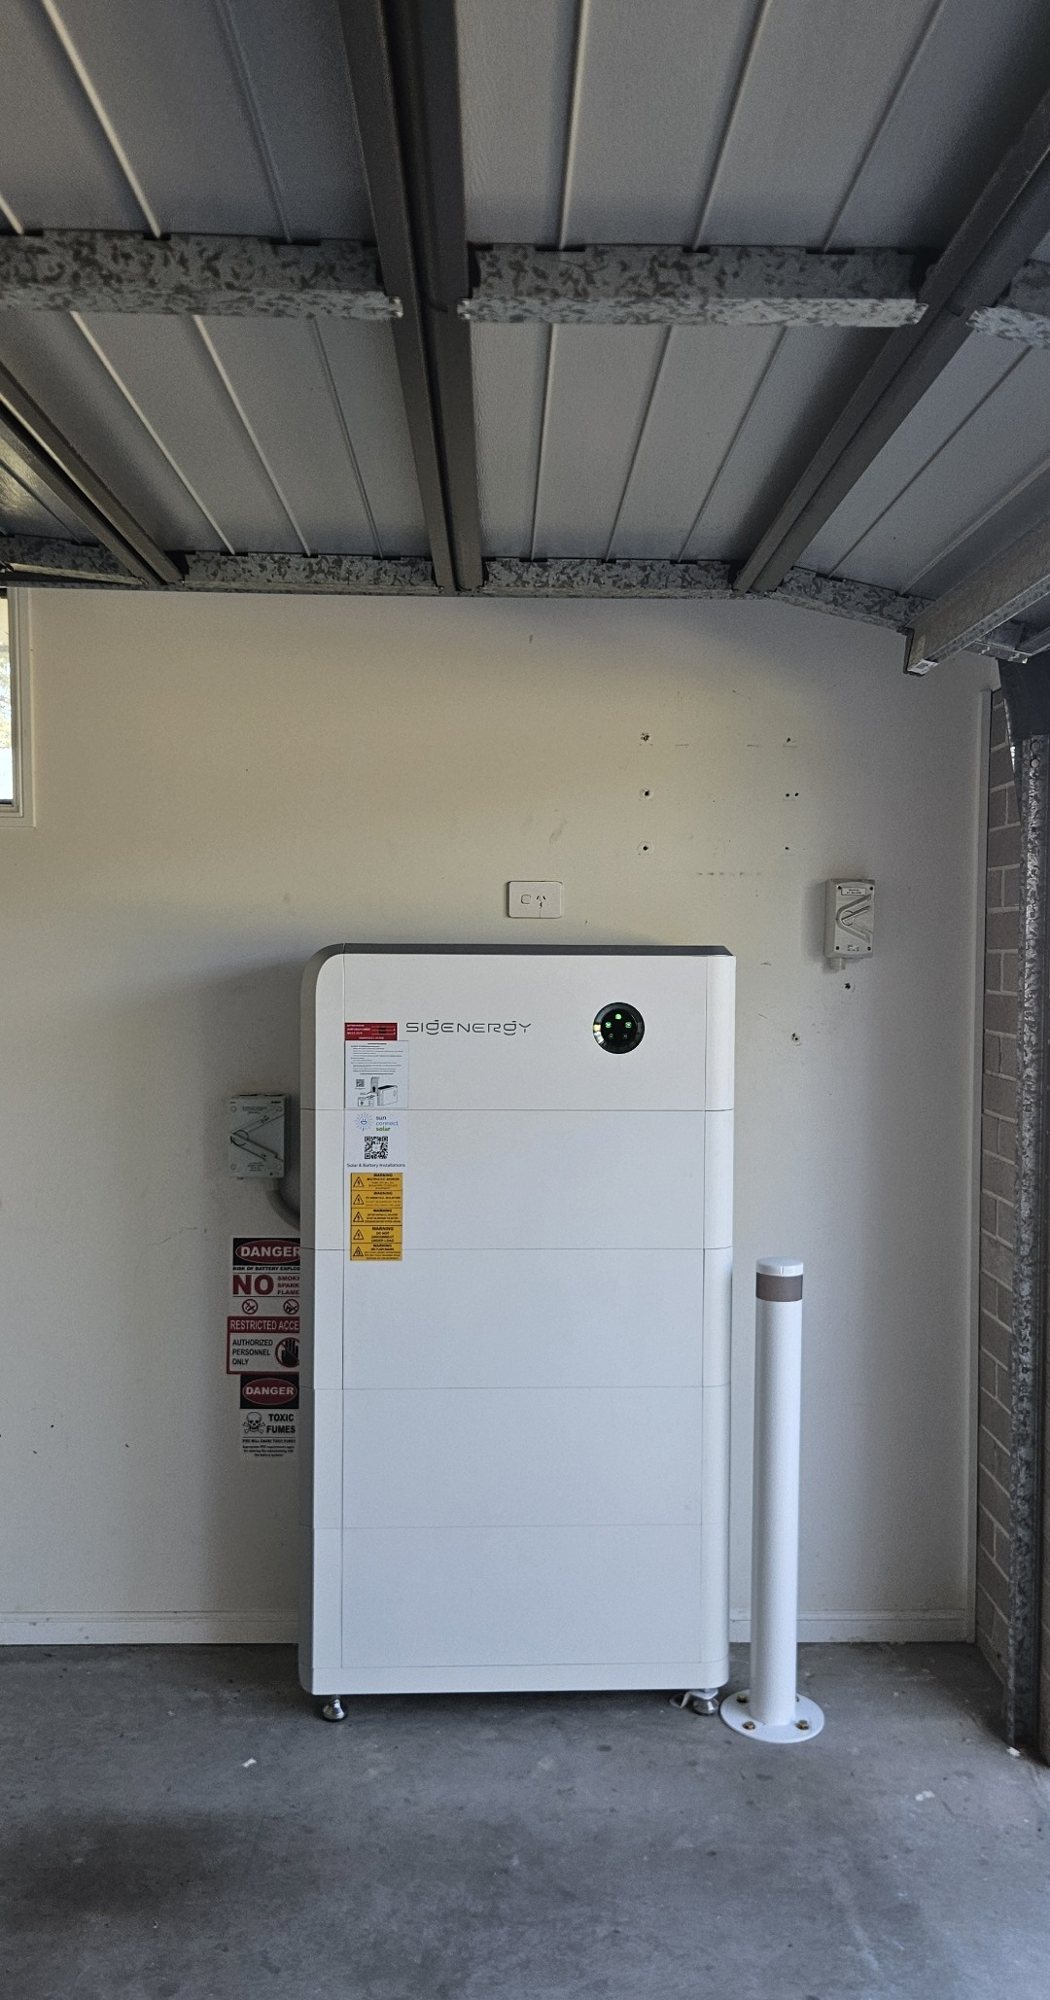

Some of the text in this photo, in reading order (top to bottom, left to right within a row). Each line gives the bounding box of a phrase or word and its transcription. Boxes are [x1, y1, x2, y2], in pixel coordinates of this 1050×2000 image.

[240, 1246, 300, 1257] DANGER
[233, 1274, 274, 1295] NO
[230, 1319, 277, 1330] RESTRICTED
[232, 1348, 271, 1356] PERSONNEL
[245, 1386, 295, 1395] DANGER
[268, 1413, 295, 1422] TOXIC
[266, 1425, 296, 1434] FUMES
